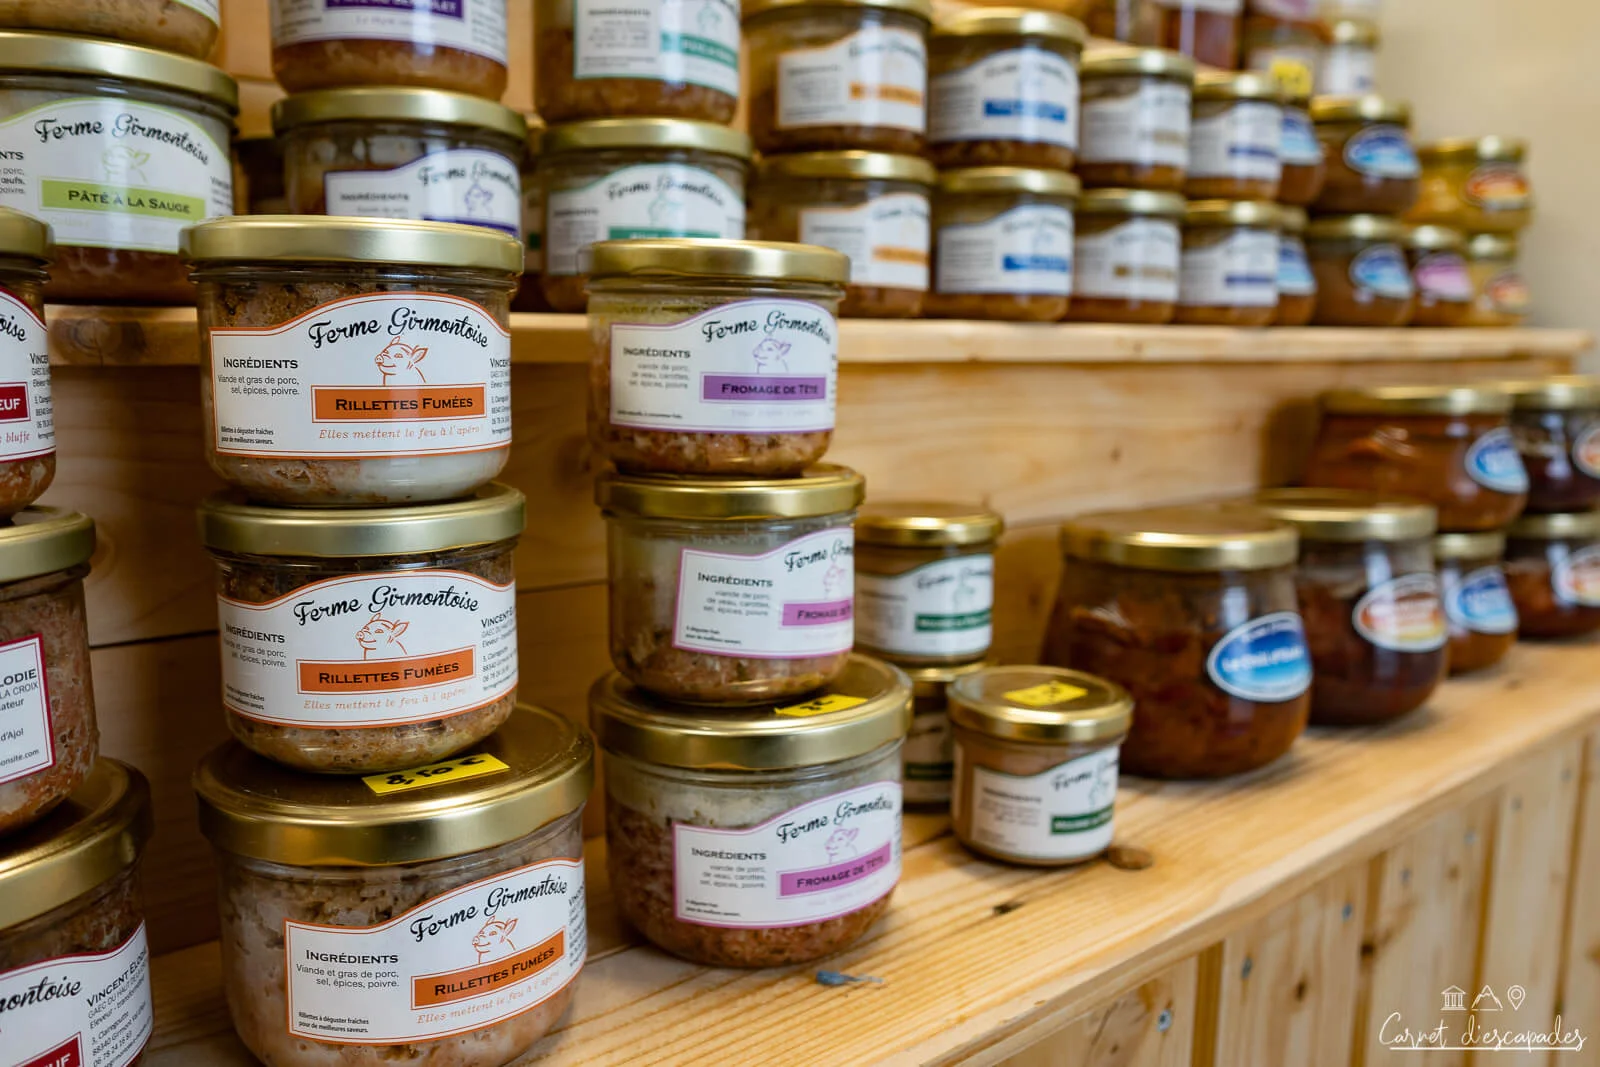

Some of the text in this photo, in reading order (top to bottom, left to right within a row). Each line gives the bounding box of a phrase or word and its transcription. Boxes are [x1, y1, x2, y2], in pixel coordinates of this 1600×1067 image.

[34, 118, 104, 143] Ferme
[68, 189, 109, 204] PÂTÉ
[127, 197, 145, 208] LA
[148, 198, 191, 214] SAUGE
[0, 315, 28, 342] oise
[308, 307, 488, 349] Ferme Girmontoise
[702, 319, 759, 343] Ferme
[623, 346, 691, 359] INGRÉDIENTS
[223, 356, 299, 369] INGRÉDIENTS
[246, 376, 262, 385] gras
[264, 376, 275, 384] de
[277, 377, 300, 386] porc,
[721, 383, 780, 395] FROMAGE
[271, 387, 300, 396] poivre.
[335, 396, 473, 411] RILLETTES FUMÉES
[319, 429, 348, 439] Elles
[353, 428, 401, 439] mettent
[697, 572, 773, 588] INGRÉDIENTS
[293, 585, 478, 626] Ferme Girmontoise
[225, 621, 286, 643] INGRÉDIENTS
[267, 648, 287, 659] porc,
[262, 658, 287, 668] poivre.
[319, 662, 459, 684] RILLETTES FUMÉES
[13, 681, 38, 696] CROIX
[0, 698, 24, 711] ateur
[304, 699, 331, 710] Elles
[335, 699, 382, 710] mettent
[1, 728, 24, 742] d'Ajol
[0, 748, 39, 767] onsite.com
[776, 815, 829, 844] Ferme
[691, 847, 767, 860] INGRÉDIENTS
[797, 868, 850, 888] FROMAGE
[410, 873, 567, 942] Ferme Girmontoise
[305, 949, 399, 964] INGRÉDIENTS
[296, 963, 325, 976] Viande
[337, 971, 358, 980] gras
[360, 970, 373, 978] de
[375, 971, 399, 980] porc,
[434, 947, 555, 996] RILLETTES FUMÉES
[87, 969, 129, 1007] VINCENT
[315, 978, 400, 989] sel, épices, poivre.
[417, 1012, 447, 1024] Elles
[450, 1000, 494, 1018] mettent
